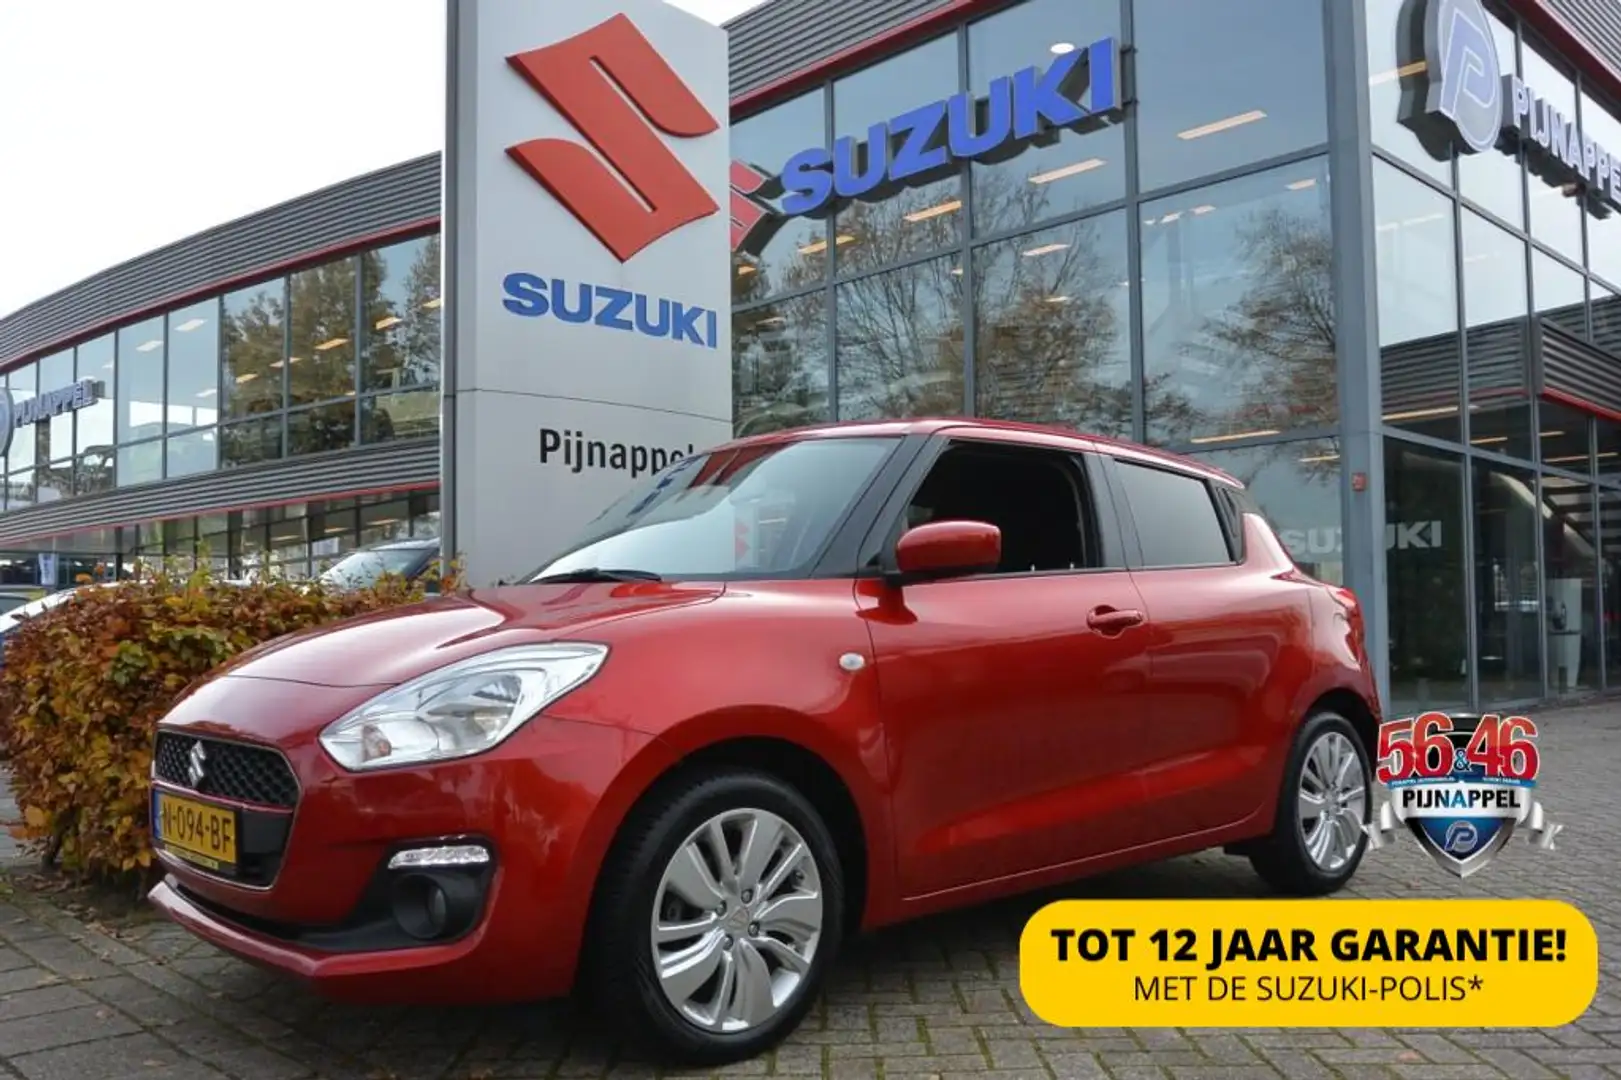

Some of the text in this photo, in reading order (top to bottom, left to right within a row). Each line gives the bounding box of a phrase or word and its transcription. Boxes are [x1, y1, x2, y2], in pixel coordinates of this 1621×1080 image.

[780, 36, 1115, 216] SUZUKI
[502, 271, 718, 350] SUZUKI
[539, 427, 695, 479] Pijnapp
[1278, 519, 1443, 555] SUKI
[162, 801, 233, 854] N-094-BF
